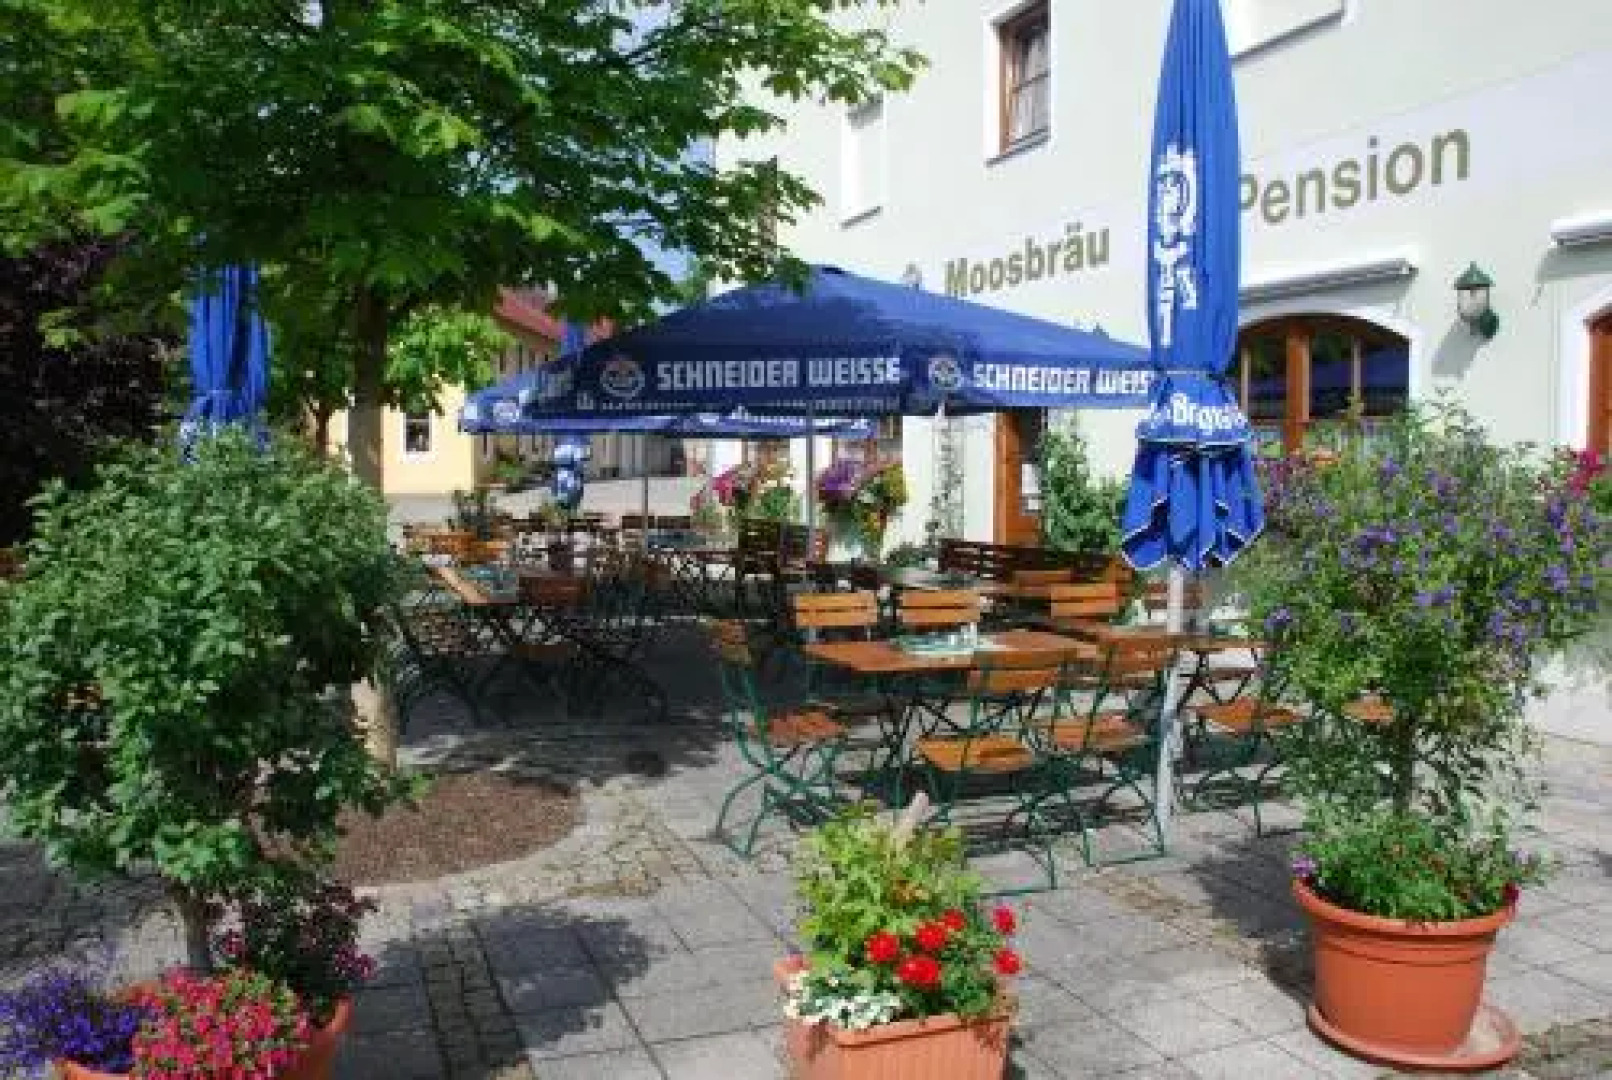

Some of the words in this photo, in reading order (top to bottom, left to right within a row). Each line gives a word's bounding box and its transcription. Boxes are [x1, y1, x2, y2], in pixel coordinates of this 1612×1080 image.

[945, 222, 1111, 298] Moosbräu
[656, 360, 798, 390] SCHNEIDER
[808, 357, 901, 385] WEISSE
[972, 363, 1091, 393] SCHNEIDER
[1095, 369, 1151, 395] WEIS
